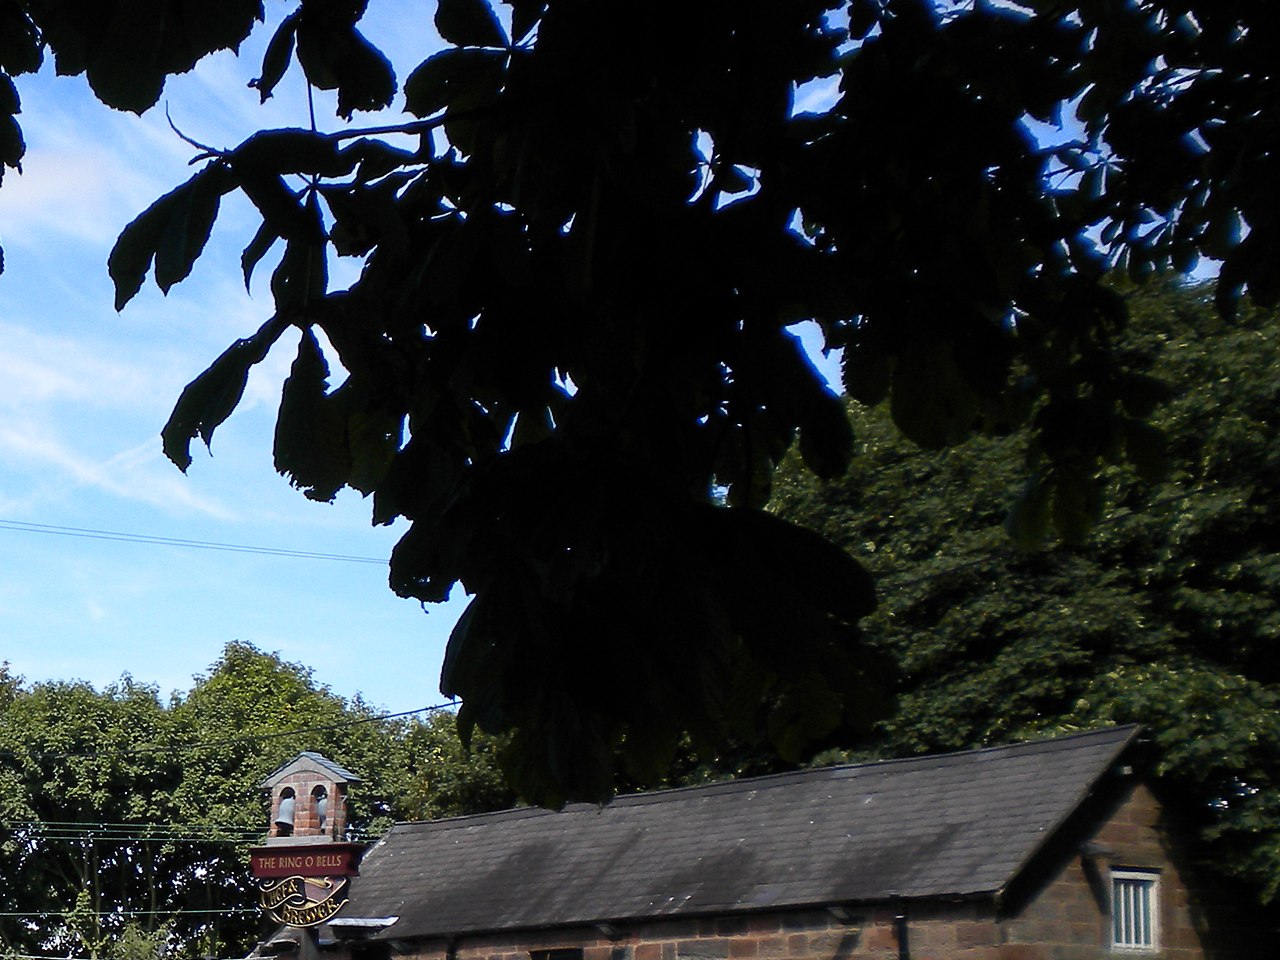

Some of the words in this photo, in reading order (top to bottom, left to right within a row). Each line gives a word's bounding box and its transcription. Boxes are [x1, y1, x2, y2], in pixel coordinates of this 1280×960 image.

[259, 857, 276, 869] THE
[279, 856, 302, 868] RING
[304, 856, 314, 867] O
[316, 855, 342, 867] BELLS
